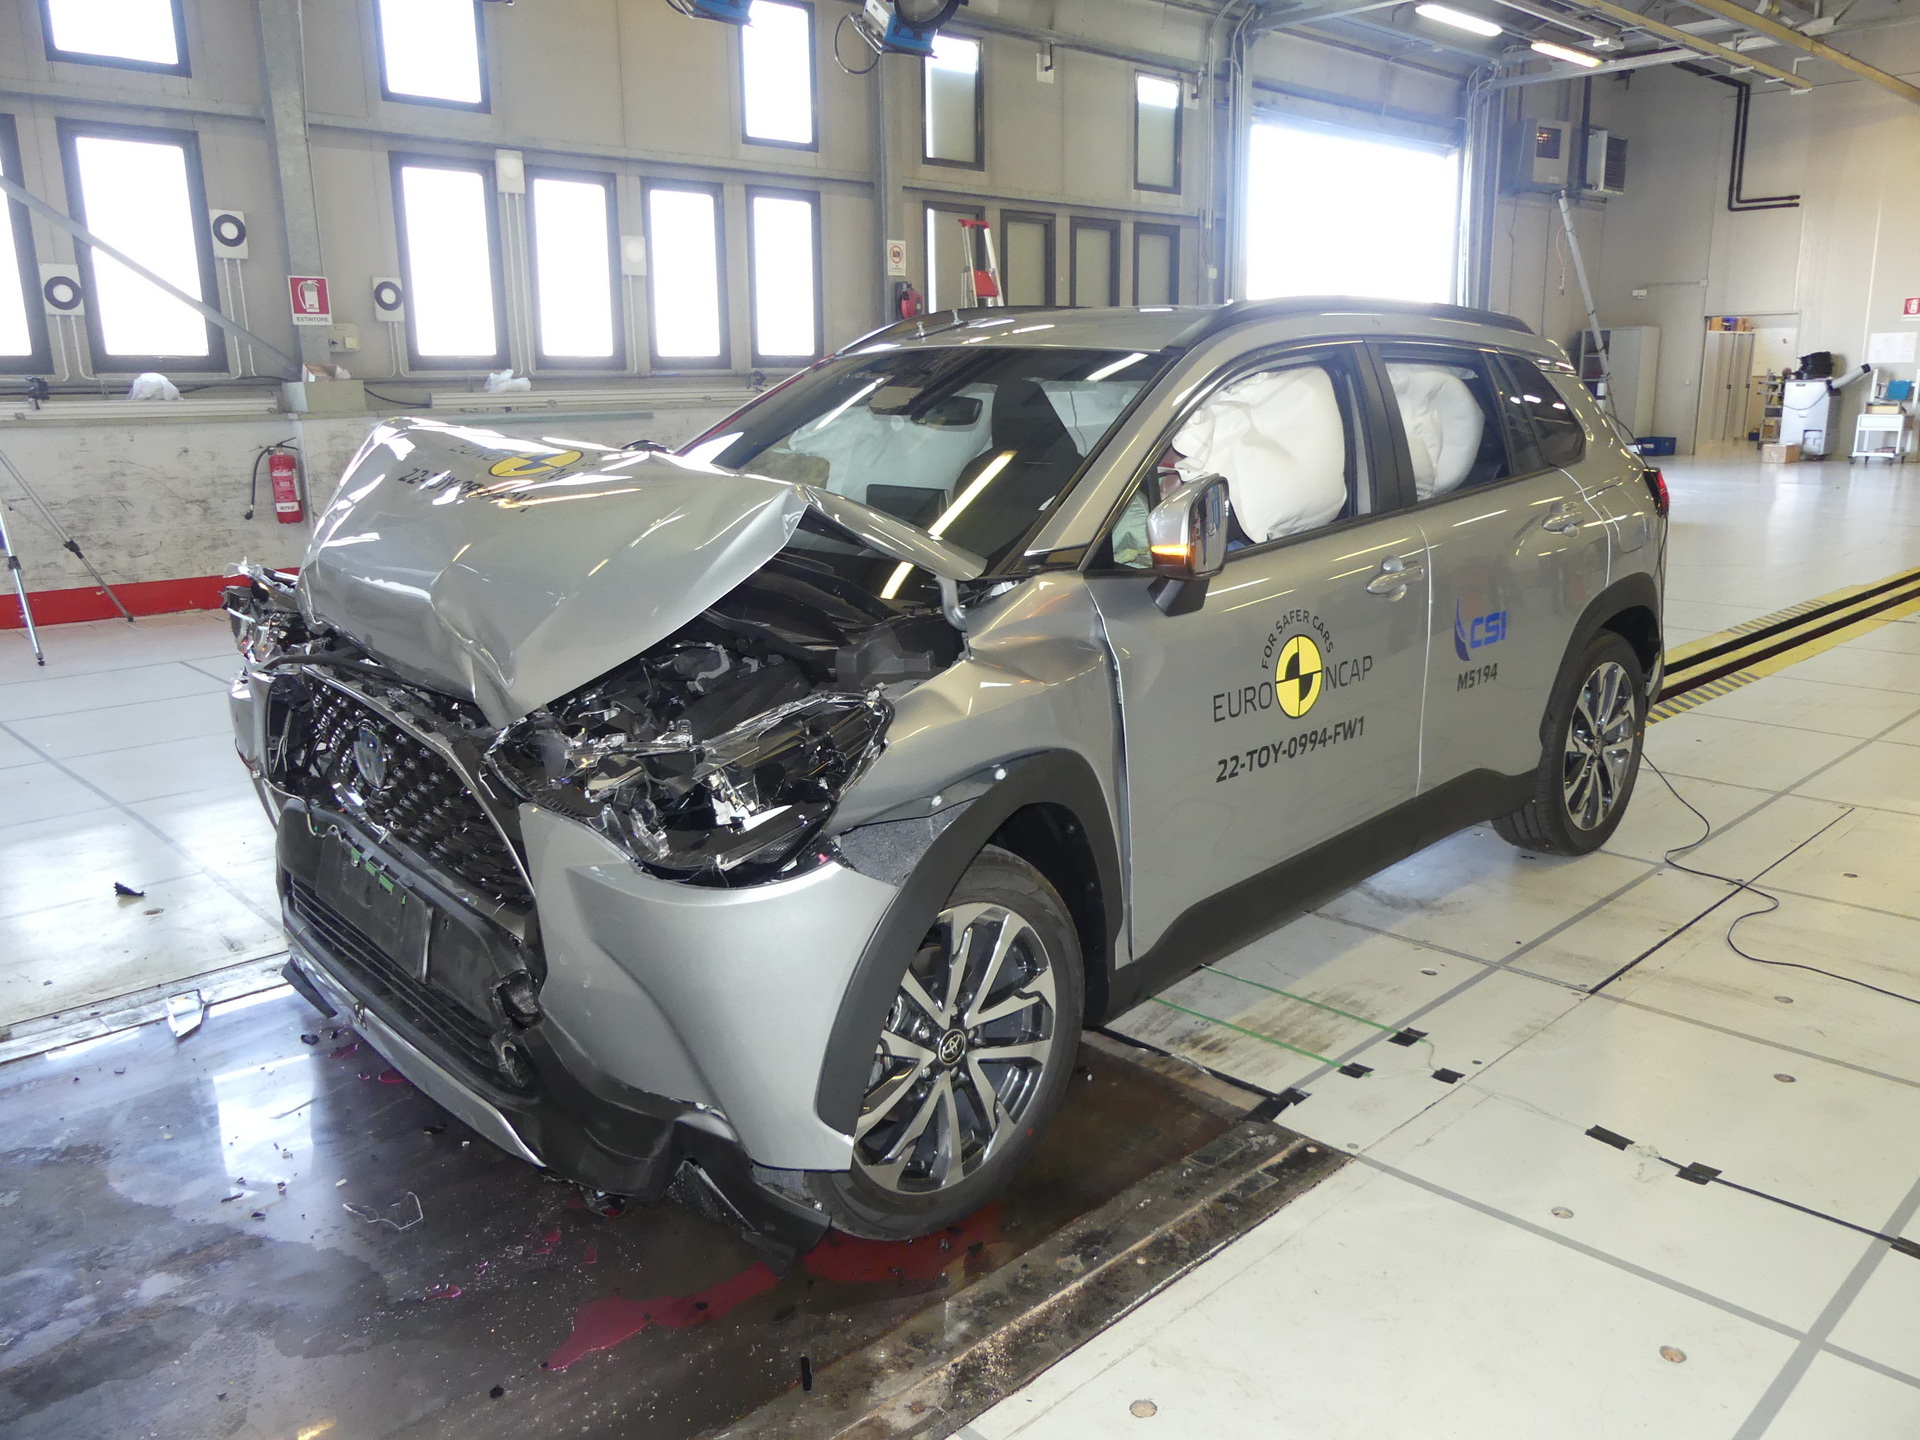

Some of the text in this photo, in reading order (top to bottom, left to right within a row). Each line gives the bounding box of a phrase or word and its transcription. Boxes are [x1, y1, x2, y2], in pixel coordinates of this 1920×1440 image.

[1261, 609, 1334, 670] FOR SAFER CARS
[1470, 610, 1508, 649] CSI
[1213, 655, 1373, 723] EURO NCAP
[1457, 662, 1499, 692] M5194
[1216, 716, 1365, 783] 22-TOY-0994-FW1
